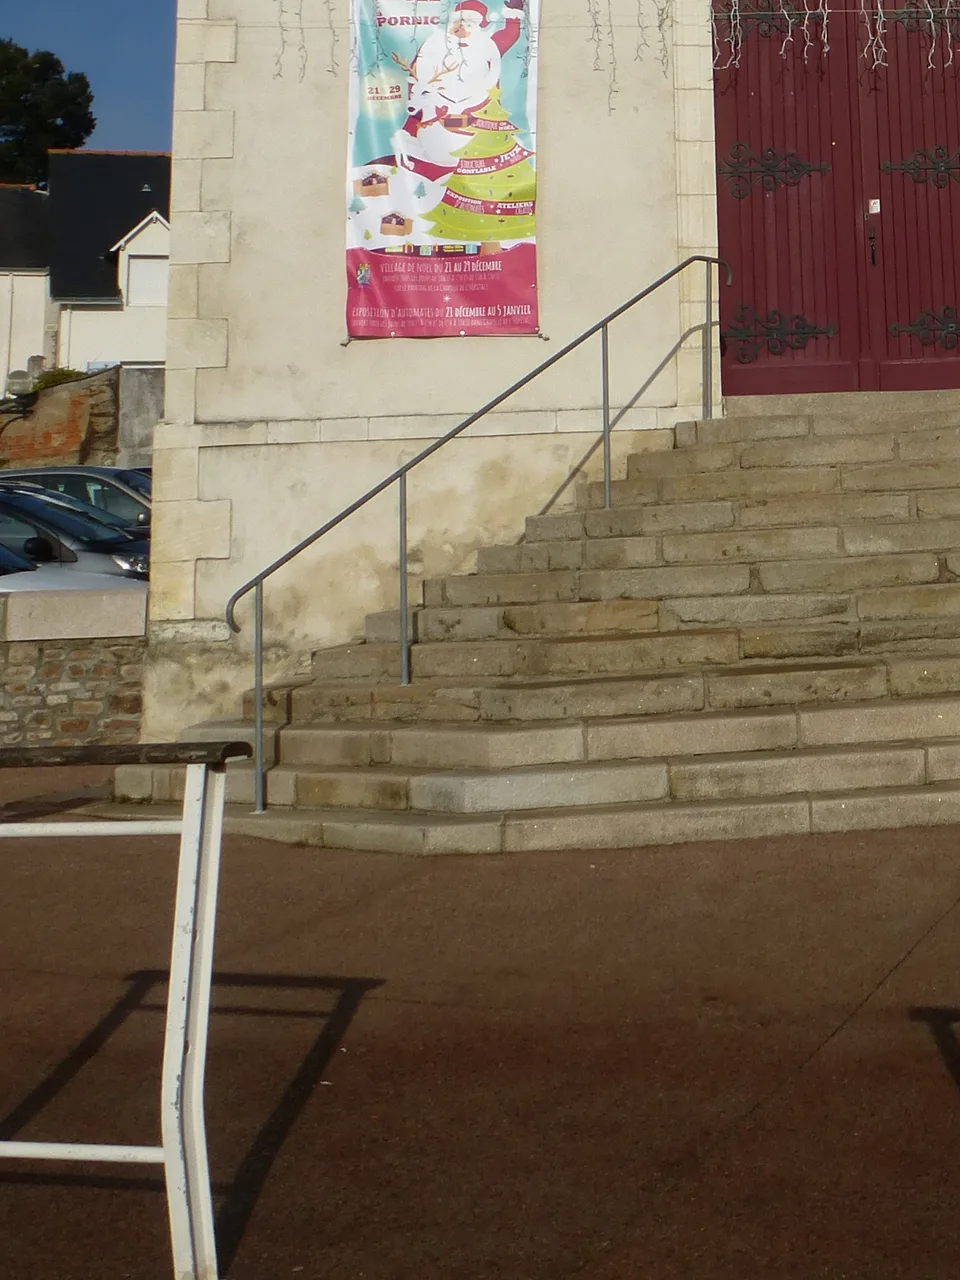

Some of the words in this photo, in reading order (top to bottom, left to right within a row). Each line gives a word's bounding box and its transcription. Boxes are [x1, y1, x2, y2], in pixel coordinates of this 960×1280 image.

[377, 16, 440, 27] PORNIC
[368, 86, 380, 95] 21
[389, 84, 401, 94] 29
[500, 144, 523, 163] JEUX
[380, 263, 406, 273] VILLAGE
[407, 263, 415, 273] DE
[434, 263, 443, 273] DU
[444, 261, 452, 273] 21
[453, 261, 462, 272] AU
[463, 261, 471, 272] 29
[471, 260, 502, 272] DÉCEMBRE
[352, 307, 389, 318] EXPOSITION
[391, 307, 434, 318] D'AUTOMATES
[435, 308, 443, 318] DU
[445, 307, 453, 318] 21
[454, 306, 486, 317] DÉCEMBRE
[487, 306, 496, 317] AU
[497, 304, 502, 316] 5
[503, 305, 531, 317] JANVIER
